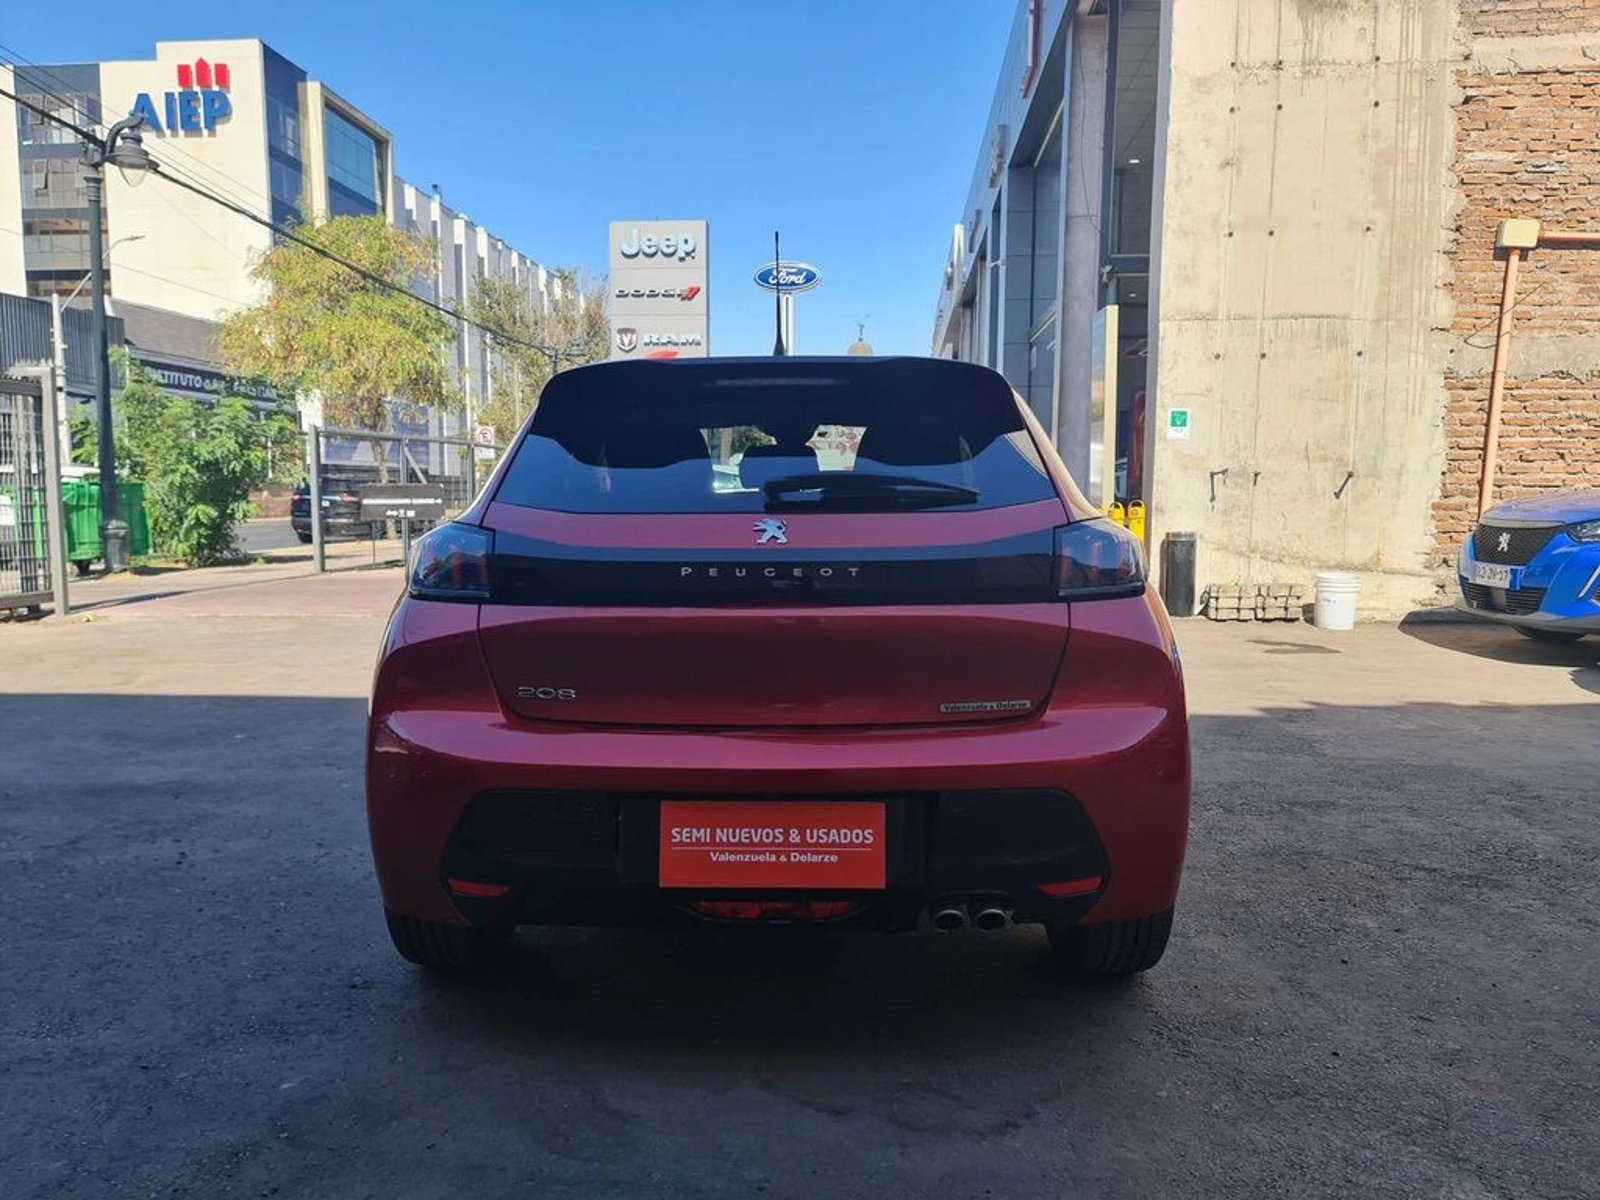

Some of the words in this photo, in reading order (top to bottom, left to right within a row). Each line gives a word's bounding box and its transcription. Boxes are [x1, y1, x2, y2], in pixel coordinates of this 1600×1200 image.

[130, 91, 233, 136] AIEP
[621, 229, 696, 261] Jeep
[769, 269, 807, 284] Ford
[643, 333, 701, 346] RAM
[680, 566, 861, 577] PEUGEOT
[518, 686, 576, 700] 208
[944, 702, 988, 712] Valenzuela
[671, 827, 711, 843] SEMI
[716, 828, 784, 843] NUEVOS
[788, 828, 801, 844] &
[806, 828, 874, 844] USADOS
[710, 851, 776, 863] Valenzuela
[779, 854, 787, 862] &
[790, 852, 839, 863] Delarze
